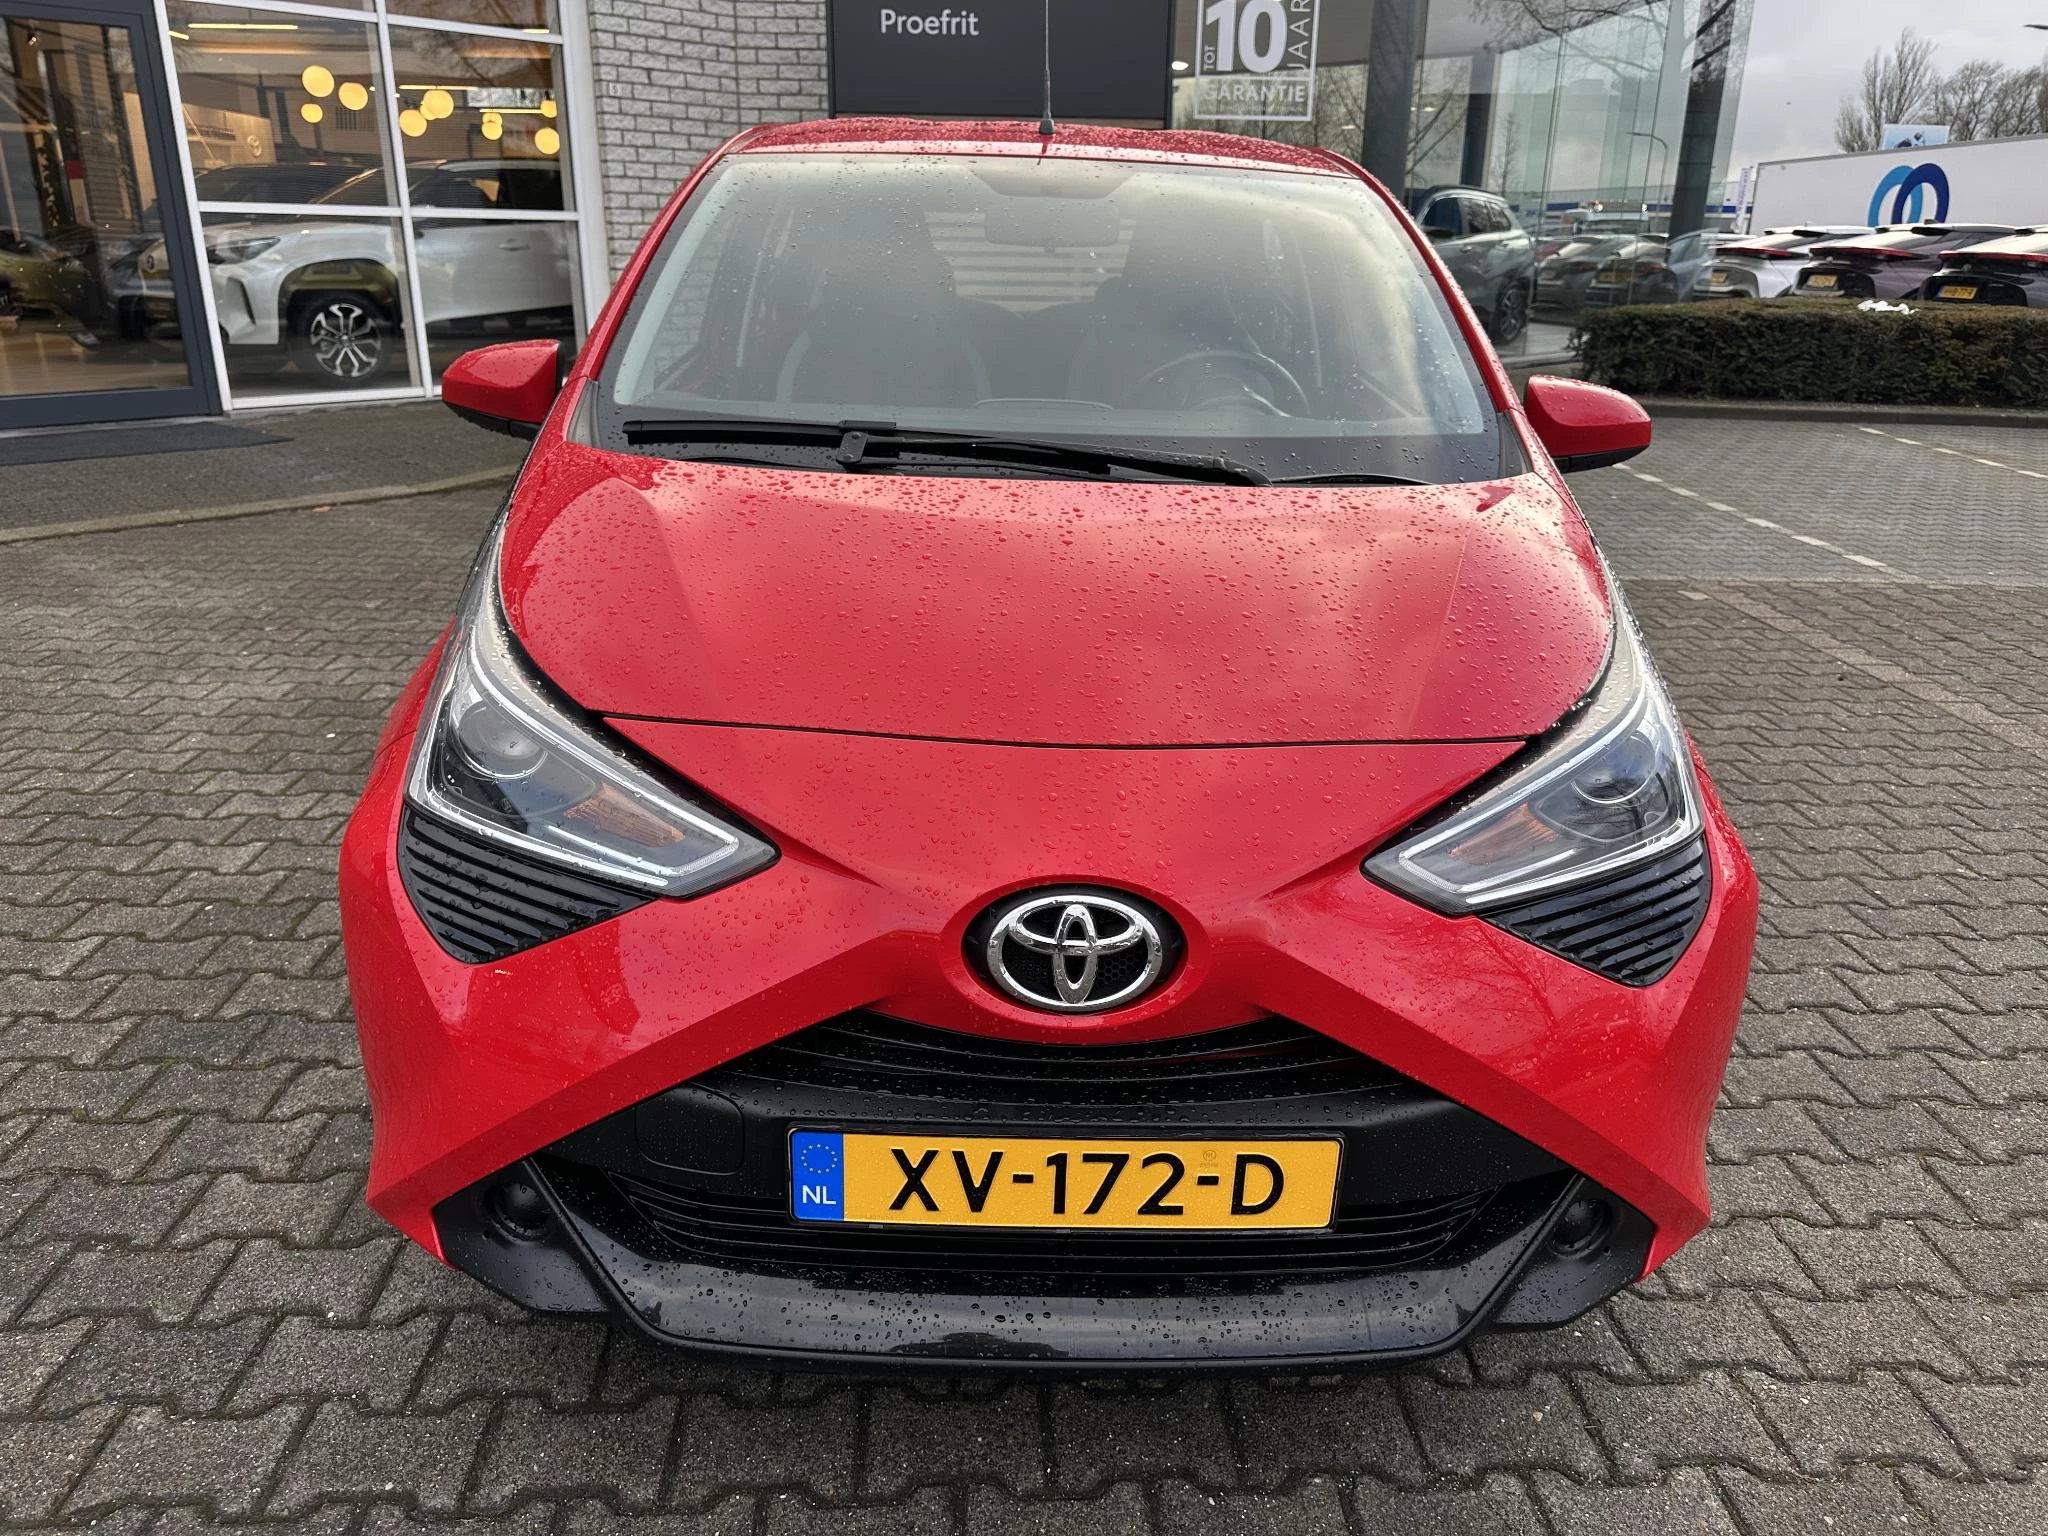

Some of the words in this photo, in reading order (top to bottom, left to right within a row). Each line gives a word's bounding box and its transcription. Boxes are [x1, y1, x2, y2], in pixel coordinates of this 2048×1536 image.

[880, 8, 980, 36] Proefrit
[1286, 0, 1311, 72] JAAR
[1205, 0, 1287, 73] 10
[1203, 44, 1216, 71] TOT
[1204, 83, 1306, 102] GARANTIE
[802, 1184, 837, 1205] NL
[888, 1148, 1285, 1215] XV-172-D
